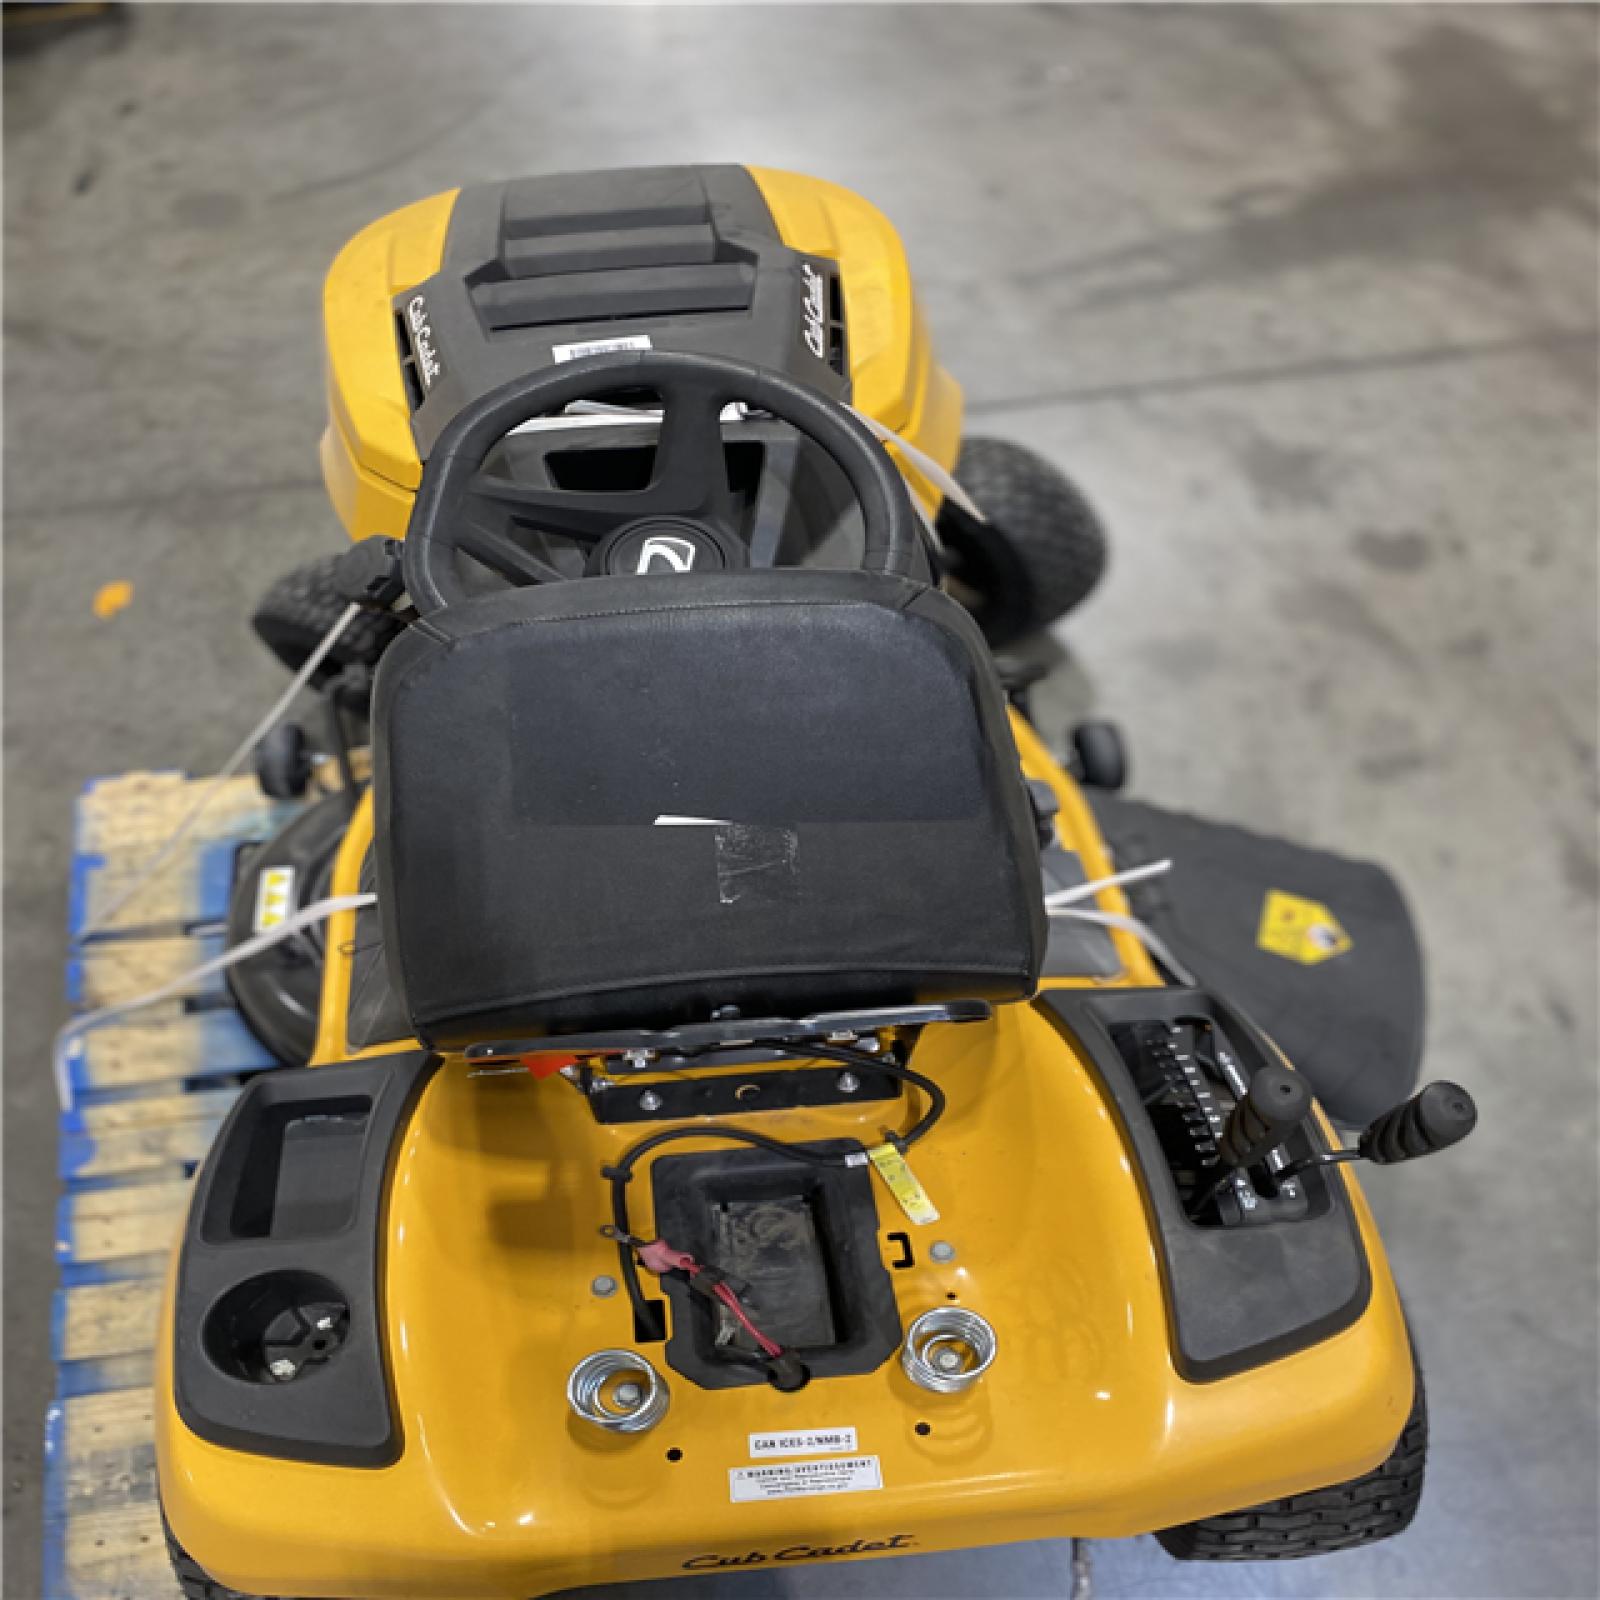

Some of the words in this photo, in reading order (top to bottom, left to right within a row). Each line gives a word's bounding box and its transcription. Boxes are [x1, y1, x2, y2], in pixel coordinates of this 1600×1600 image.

[409, 294, 427, 333] Cub
[415, 325, 440, 386] Cadet
[682, 1551, 767, 1569] Cub
[774, 1534, 914, 1560] Cadet
